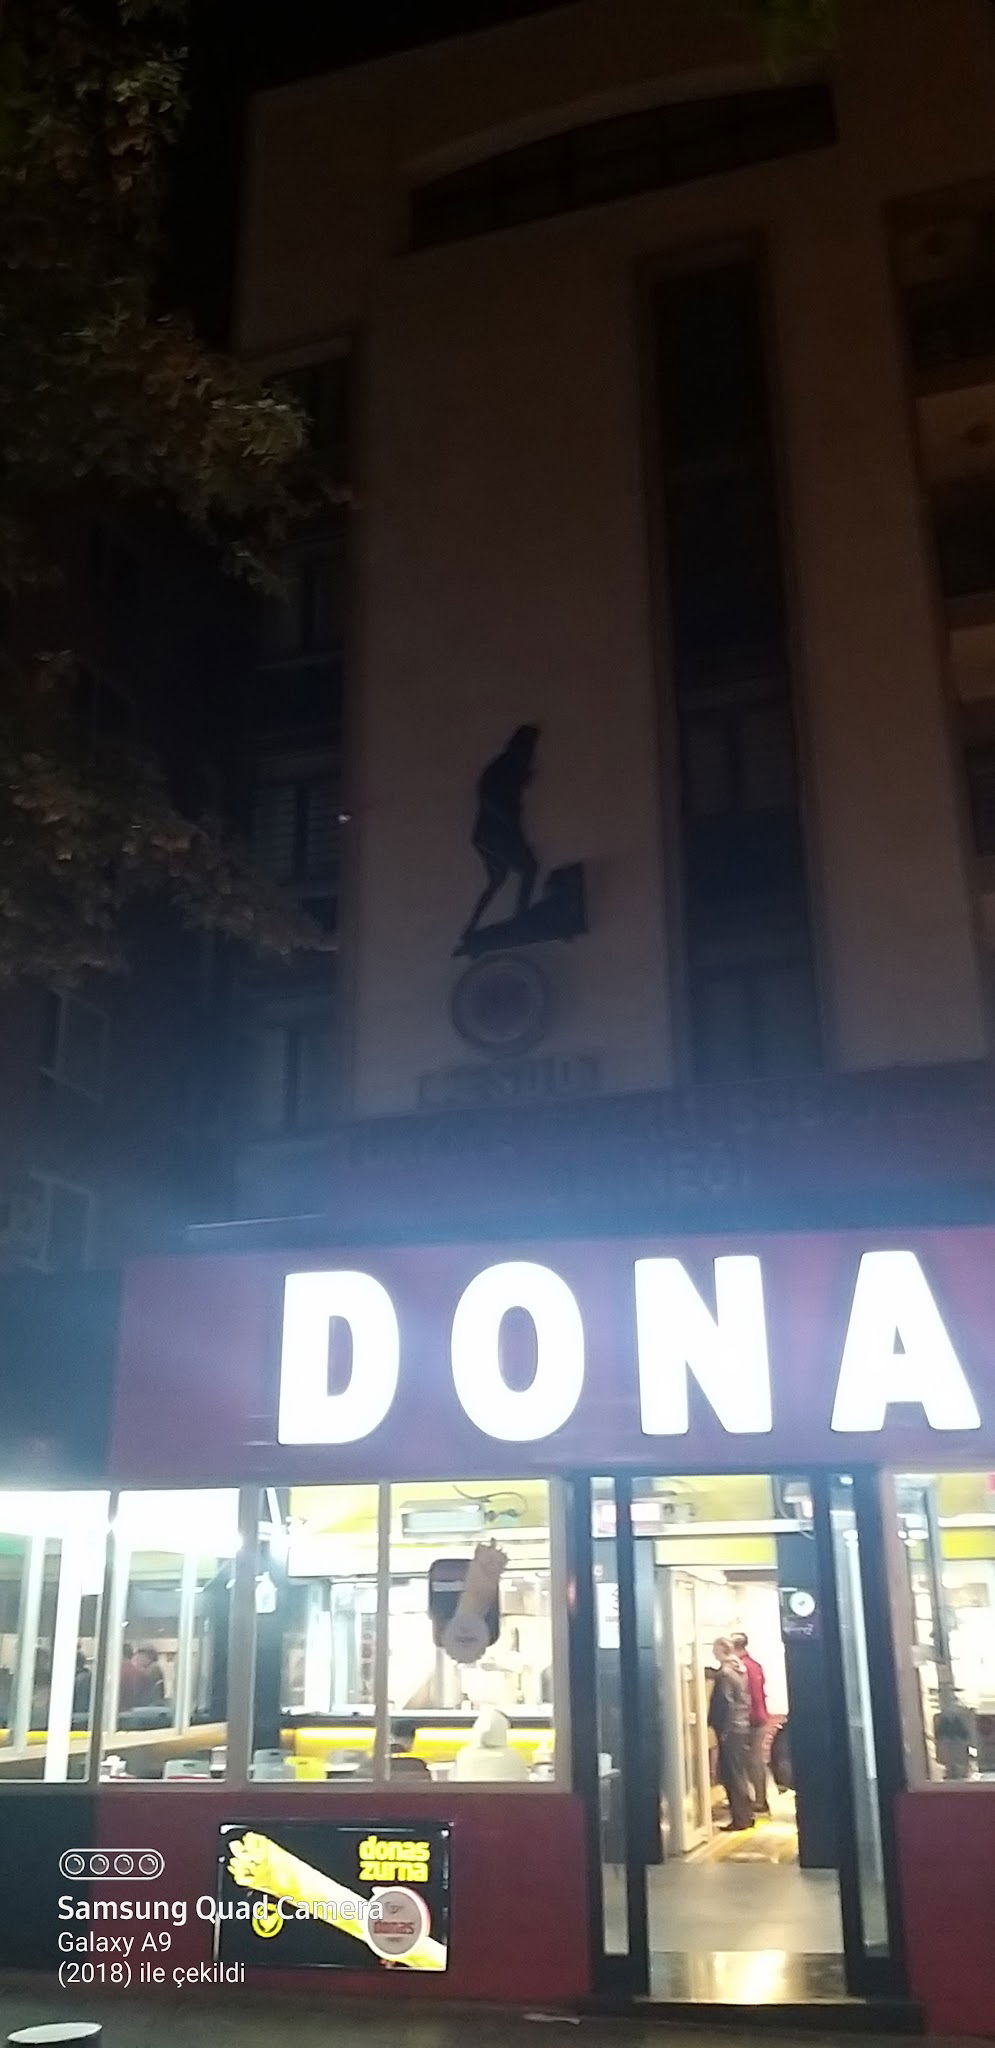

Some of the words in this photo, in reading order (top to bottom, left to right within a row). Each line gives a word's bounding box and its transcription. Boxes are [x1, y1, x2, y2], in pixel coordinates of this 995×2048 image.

[277, 1250, 981, 1446] DONA
[359, 1835, 430, 1861] donas
[359, 1860, 429, 1882] zurna
